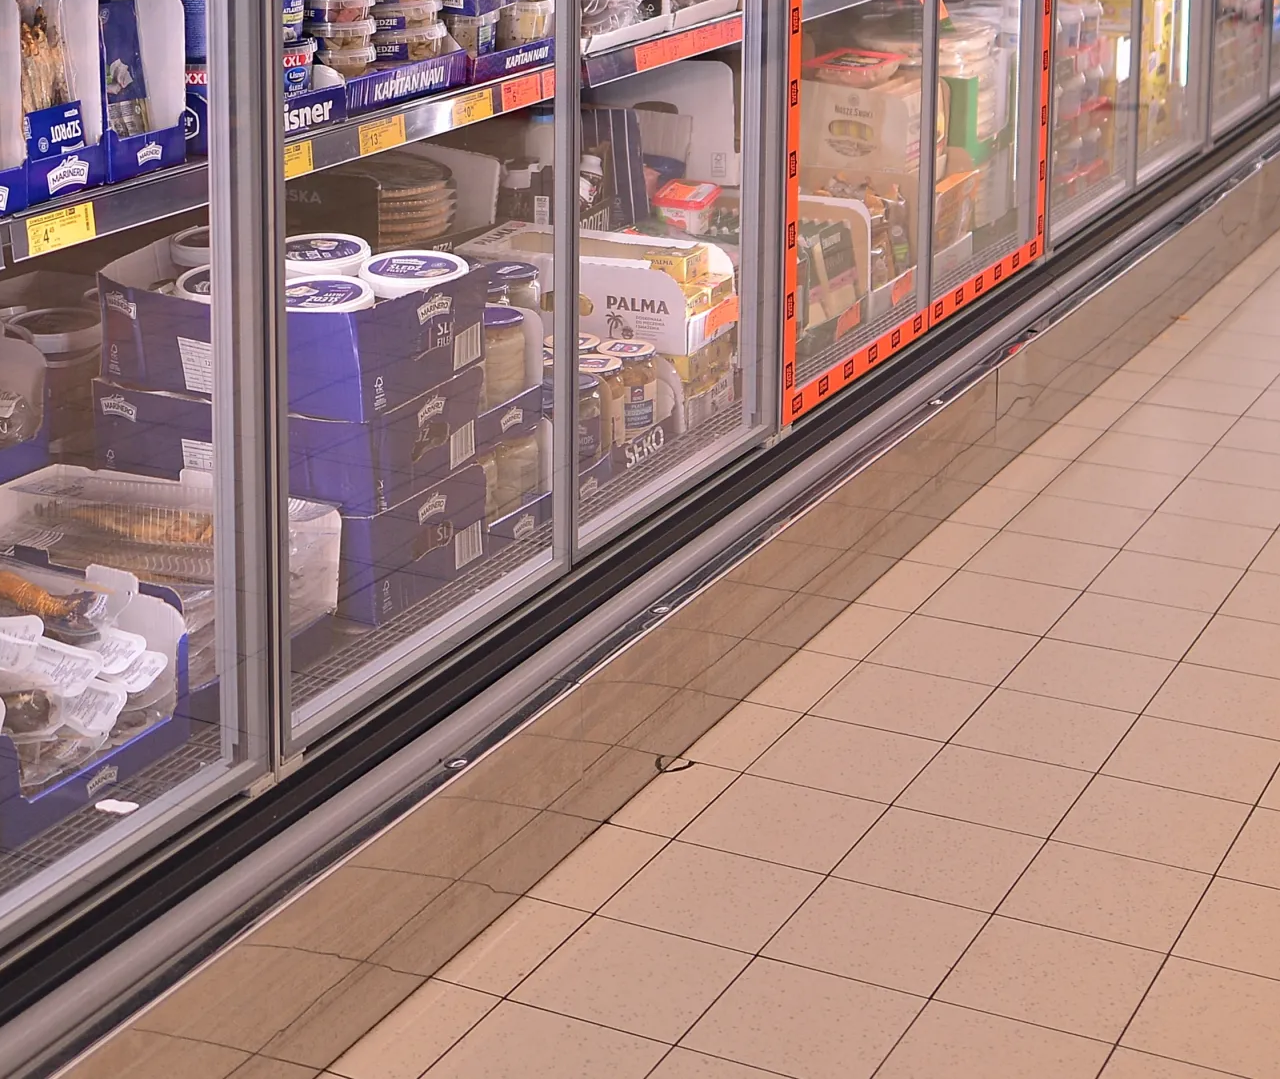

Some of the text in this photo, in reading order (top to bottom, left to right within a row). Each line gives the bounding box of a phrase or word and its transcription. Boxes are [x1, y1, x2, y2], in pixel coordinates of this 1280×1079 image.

[505, 45, 549, 70] KAPITAN NAVI
[374, 65, 444, 102] KAPITAN NAVI
[284, 100, 333, 132] isner
[50, 119, 82, 143] SZPROT
[138, 148, 160, 161] MARINERO
[51, 168, 85, 185] MARINERO
[43, 229, 50, 244] 4
[420, 301, 449, 318] MARINERO
[606, 295, 670, 315] PALMA
[102, 397, 137, 421] MARINERO
[625, 426, 664, 469] SEKO
[420, 500, 445, 519] MARINERO
